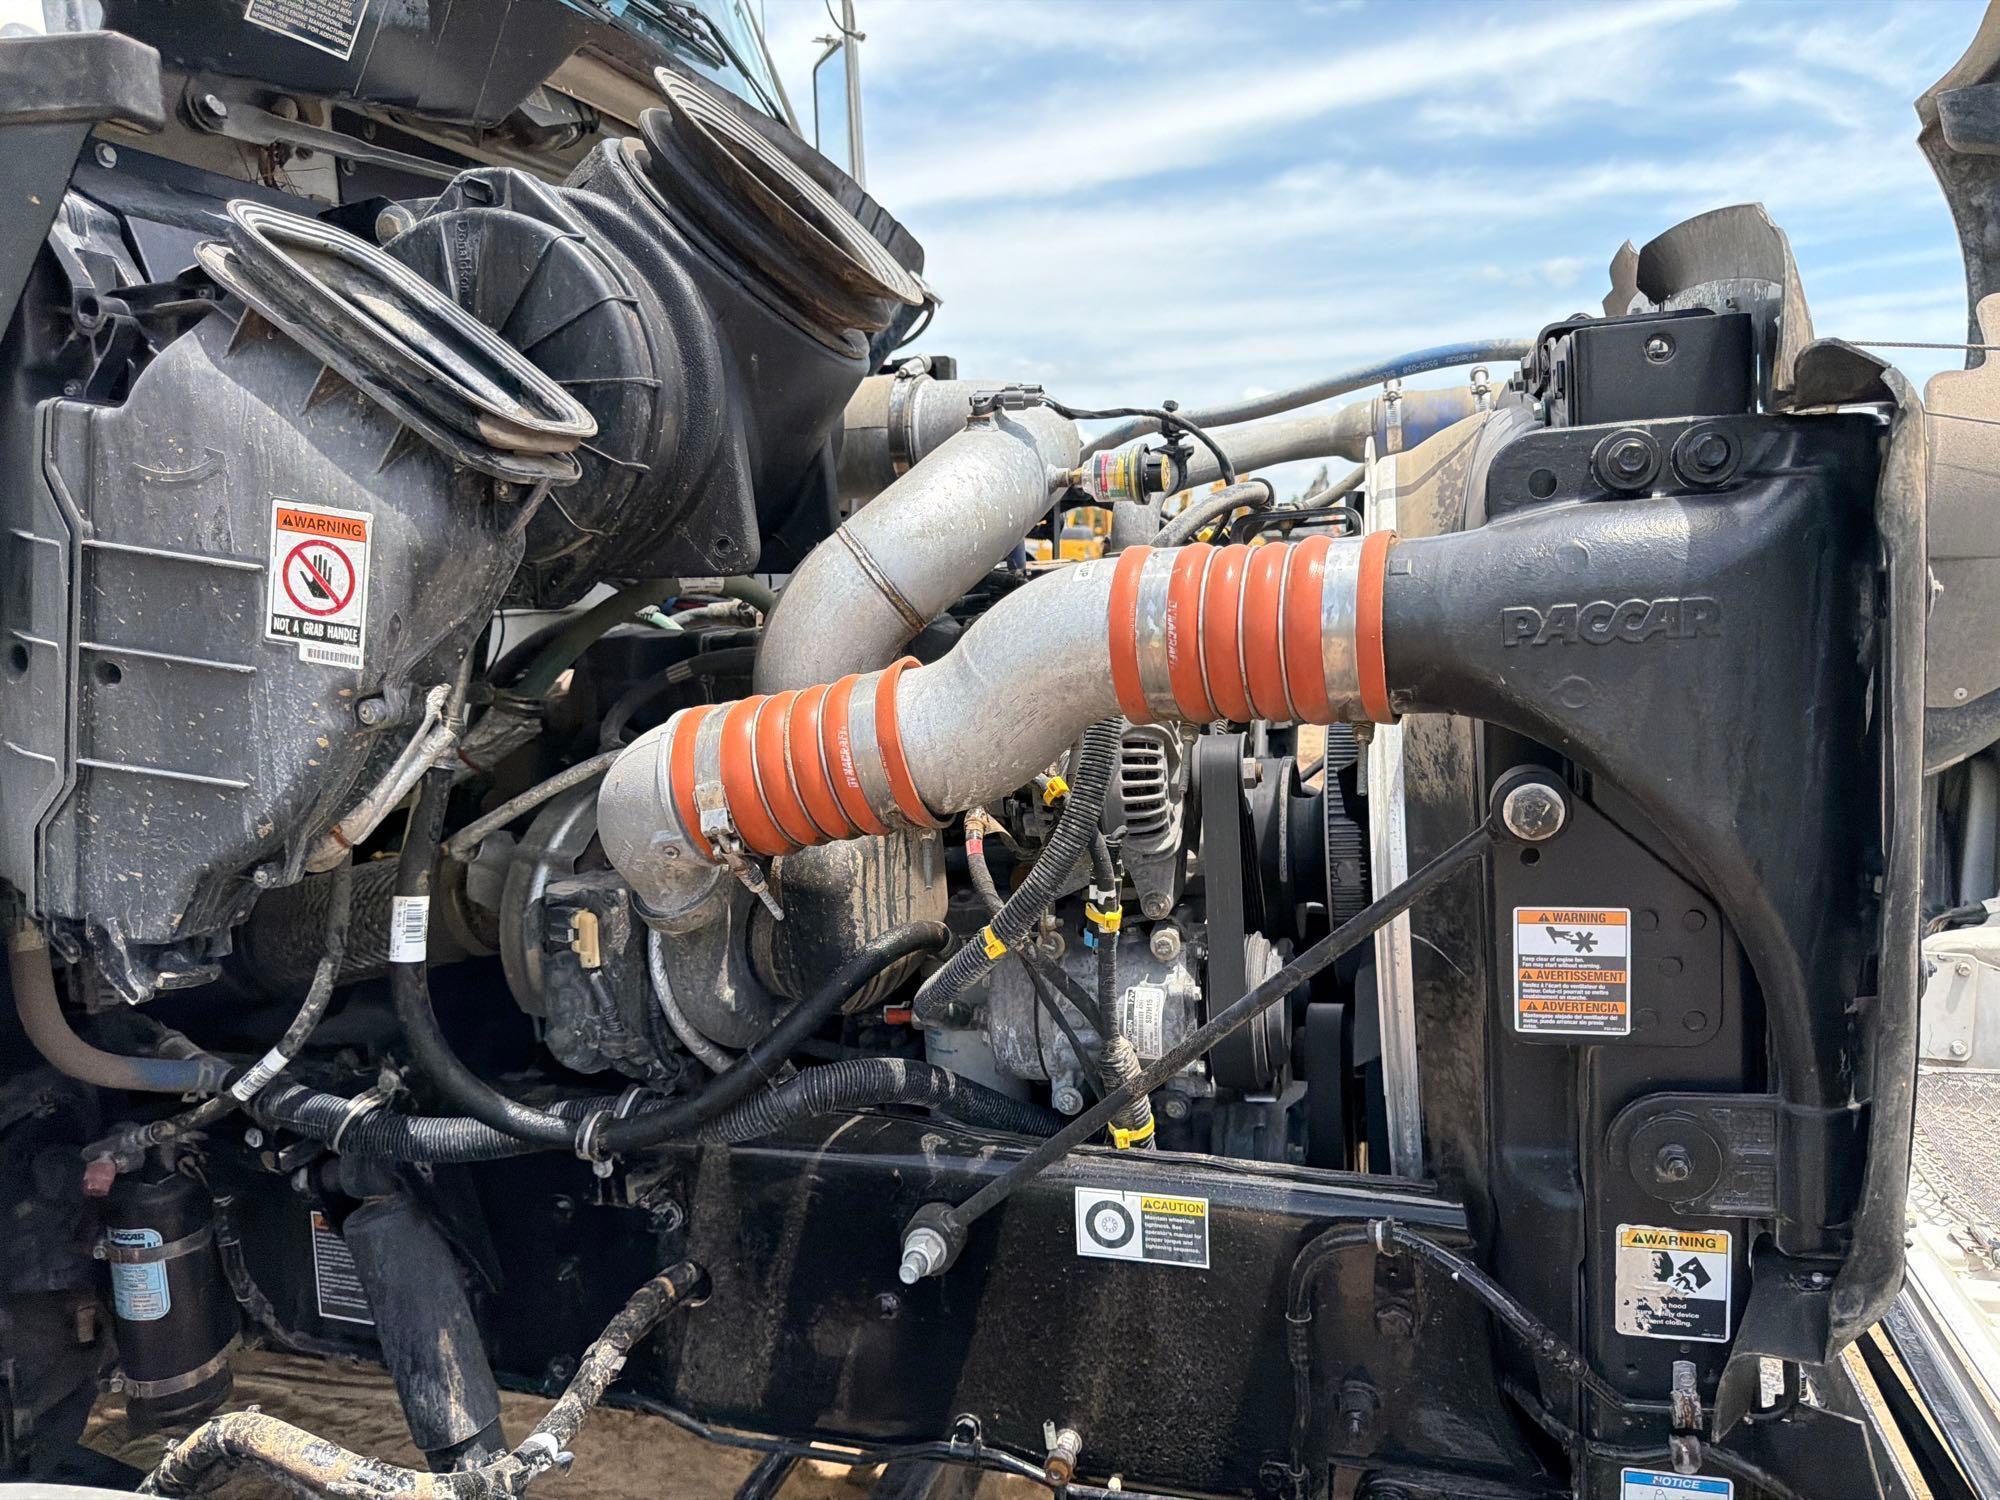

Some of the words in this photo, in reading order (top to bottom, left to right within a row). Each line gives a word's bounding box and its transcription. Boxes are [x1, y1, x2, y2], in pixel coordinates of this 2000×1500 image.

[252, 2, 286, 20] OPERATION
[284, 15, 307, 29] MANUAL
[307, 25, 319, 34] FOR
[318, 29, 350, 47] ADDITIONAL
[304, 8, 316, 17] AND
[315, 12, 344, 29] PERSONAL
[316, 5, 336, 17] COULD
[335, 13, 356, 26] RESULT
[456, 219, 473, 294] Donaldson
[295, 515, 362, 537] WARNING
[272, 616, 290, 631] NOT
[292, 619, 300, 633] A
[301, 621, 325, 637] GRAB
[326, 624, 359, 642] HANDLE
[1503, 597, 1721, 647] PACCAR
[1552, 912, 1606, 923] WARNING
[1536, 970, 1624, 982] AVERTISSEMENT
[1542, 1001, 1618, 1013] ADVERTENCIA
[1152, 1200, 1204, 1213] CAUTION
[1644, 1233, 1716, 1249] WARNING
[1652, 1476, 1700, 1489] NOTICE
